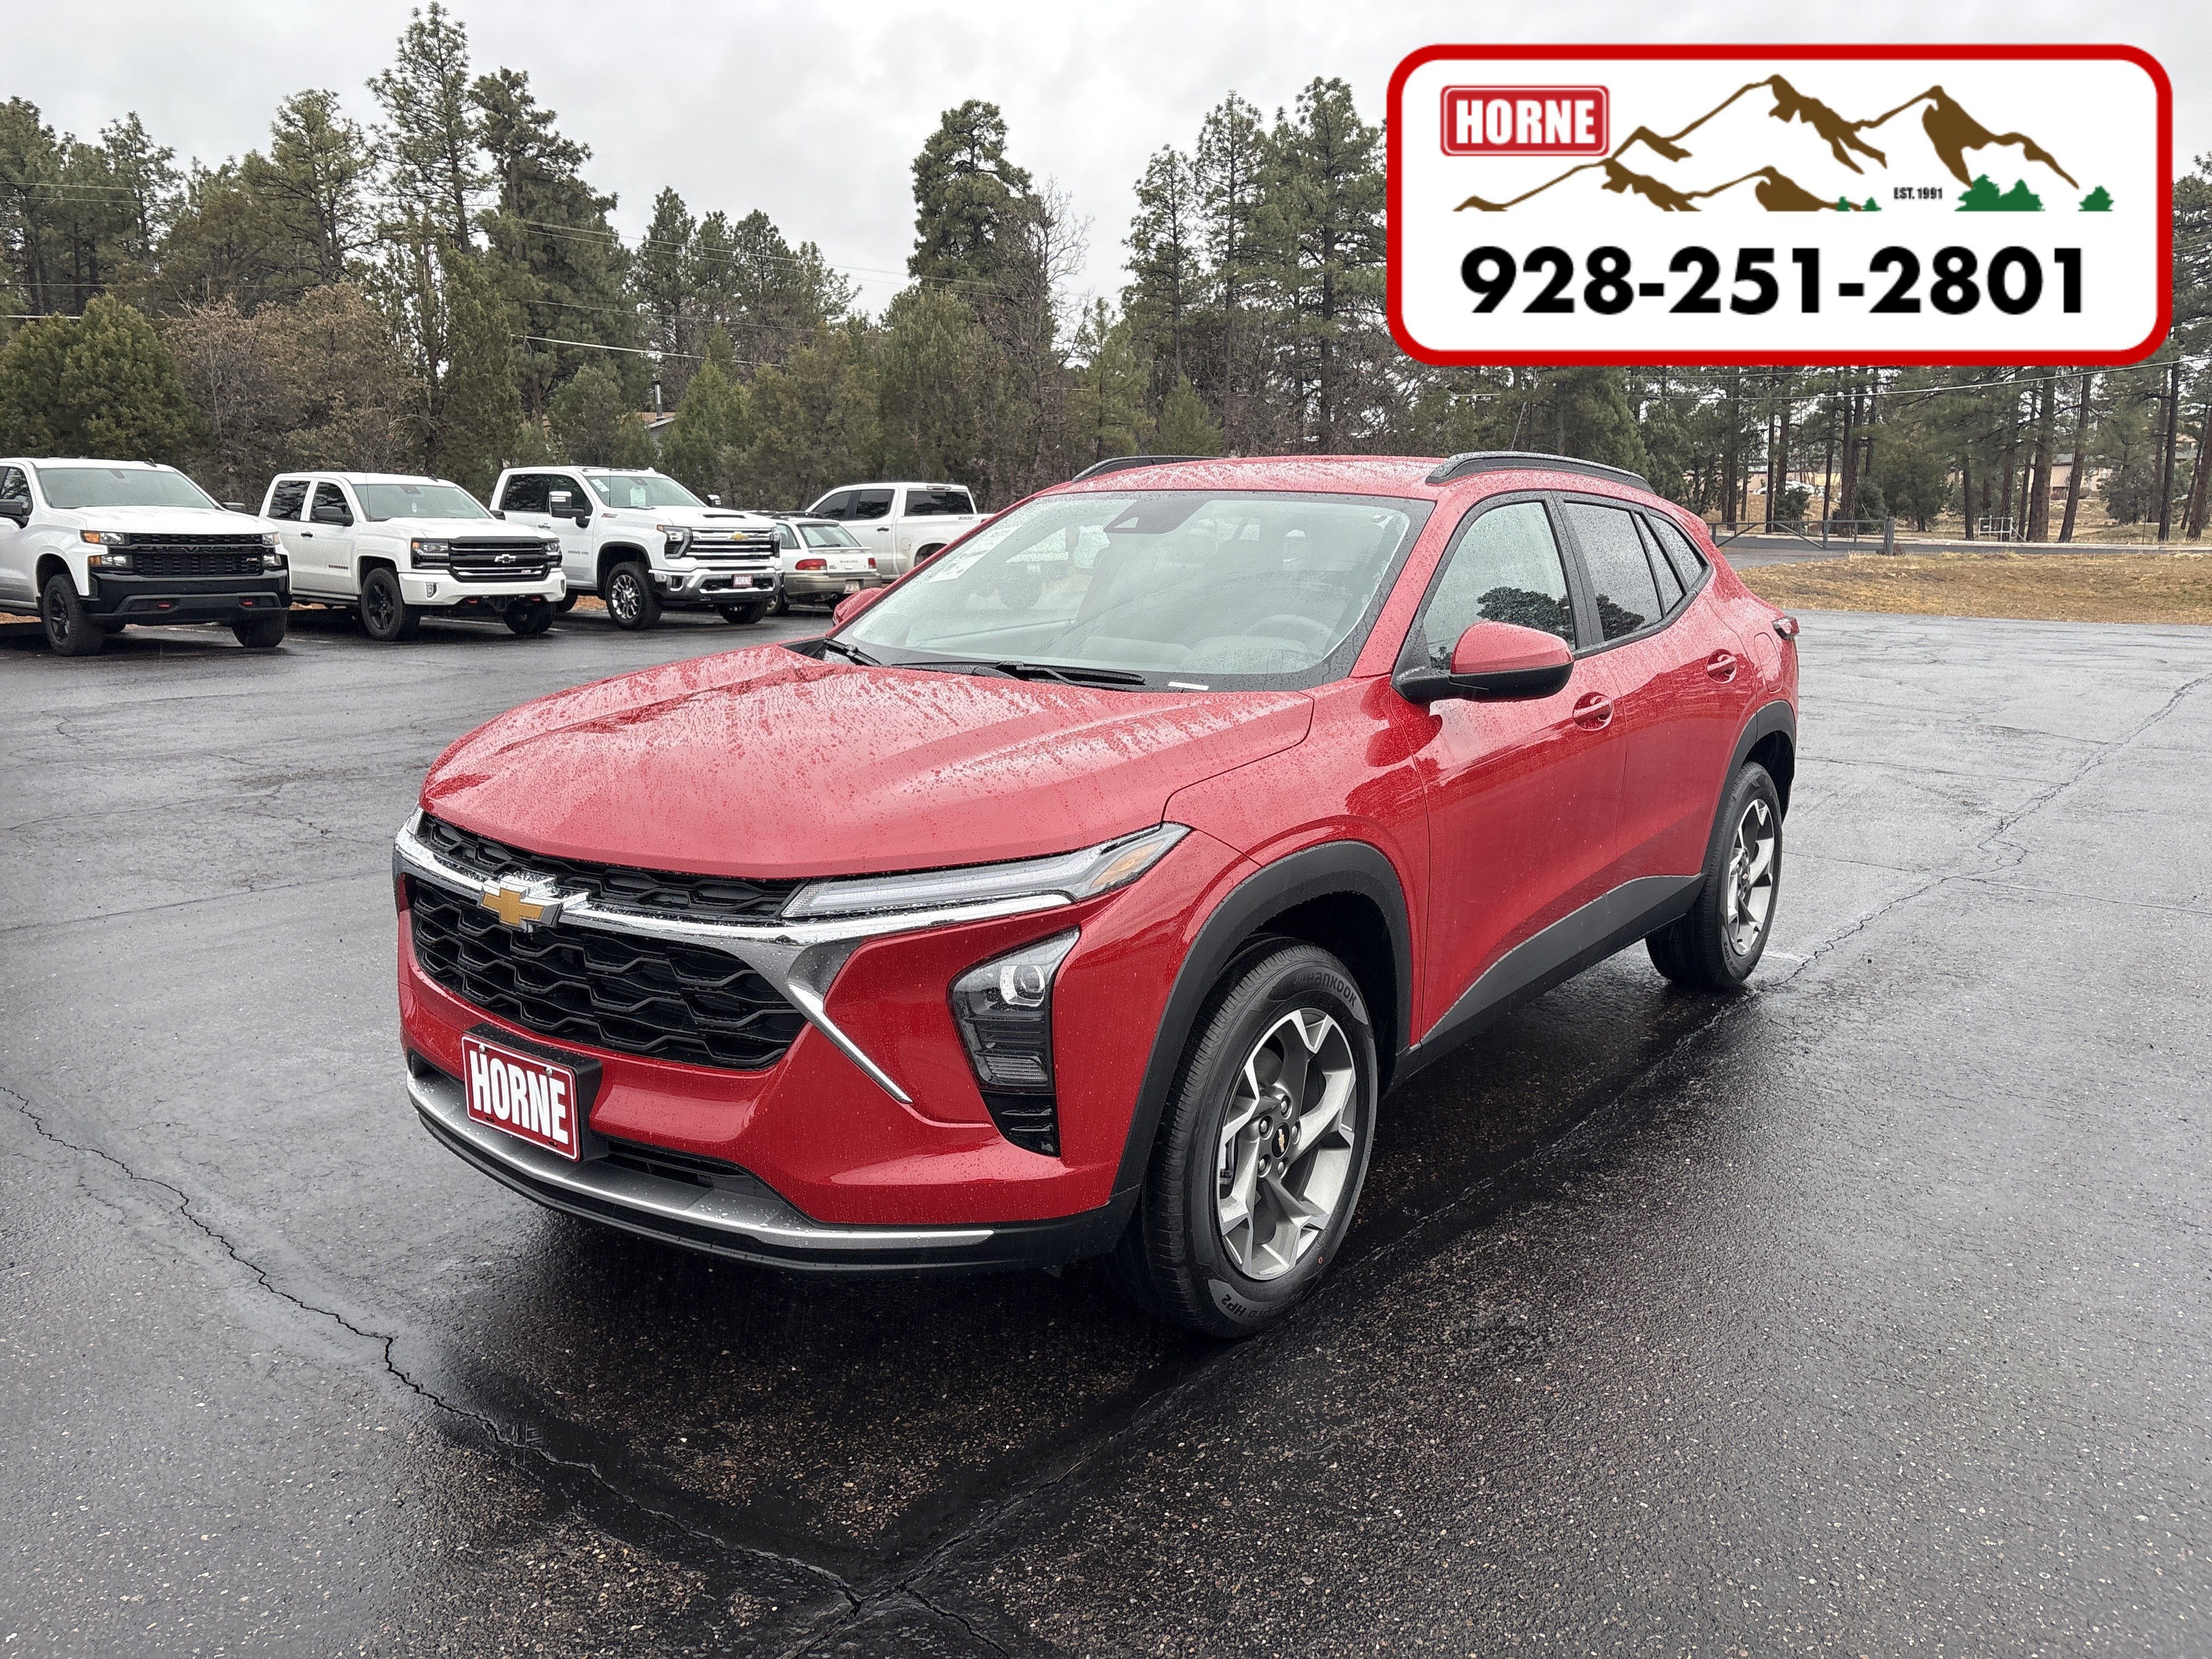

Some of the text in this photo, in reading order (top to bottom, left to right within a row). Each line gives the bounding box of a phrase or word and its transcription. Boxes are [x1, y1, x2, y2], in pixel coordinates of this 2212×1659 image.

[735, 576, 752, 585] HORNE
[469, 1049, 569, 1145] HORNE
[1221, 1294, 1247, 1317] HP2
